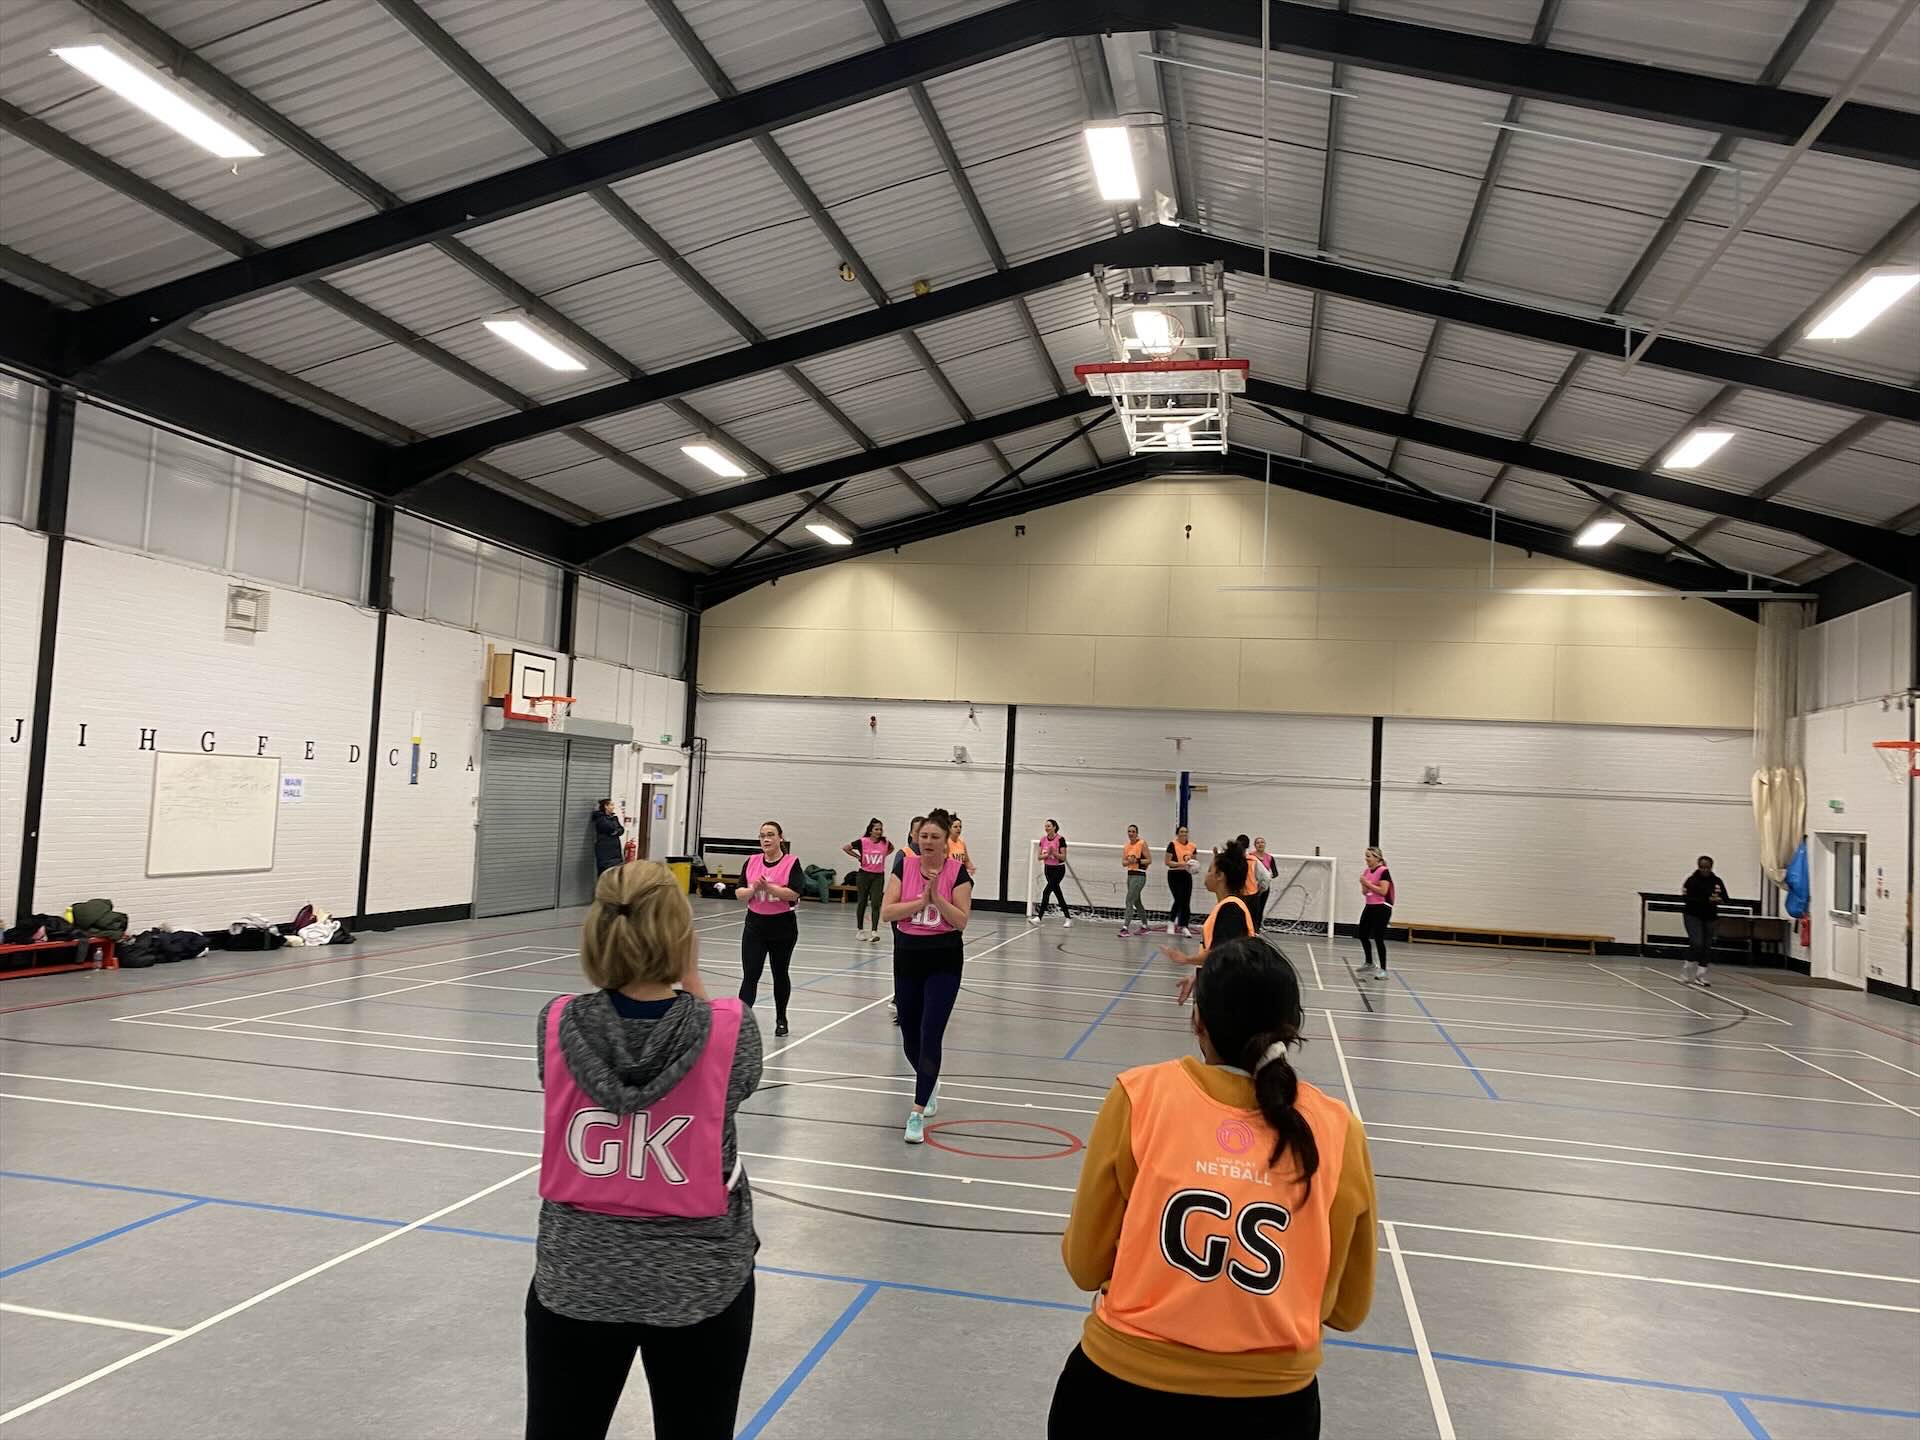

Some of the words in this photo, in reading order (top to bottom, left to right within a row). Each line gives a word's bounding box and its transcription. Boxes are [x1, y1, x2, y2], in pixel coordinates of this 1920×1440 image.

[10, 719, 24, 743] J
[78, 723, 88, 747] I
[138, 728, 157, 751] H
[200, 731, 216, 752] G
[257, 736, 269, 755] F
[304, 741, 315, 760] E
[348, 744, 361, 763] D
[389, 748, 399, 766] C
[429, 752, 438, 769] B
[465, 755, 475, 772] A
[282, 788, 301, 798] HALL
[284, 778, 303, 787] MAIN
[566, 1106, 695, 1185] GK
[1195, 1160, 1273, 1187] NETBALL
[1159, 1188, 1292, 1296] GS
